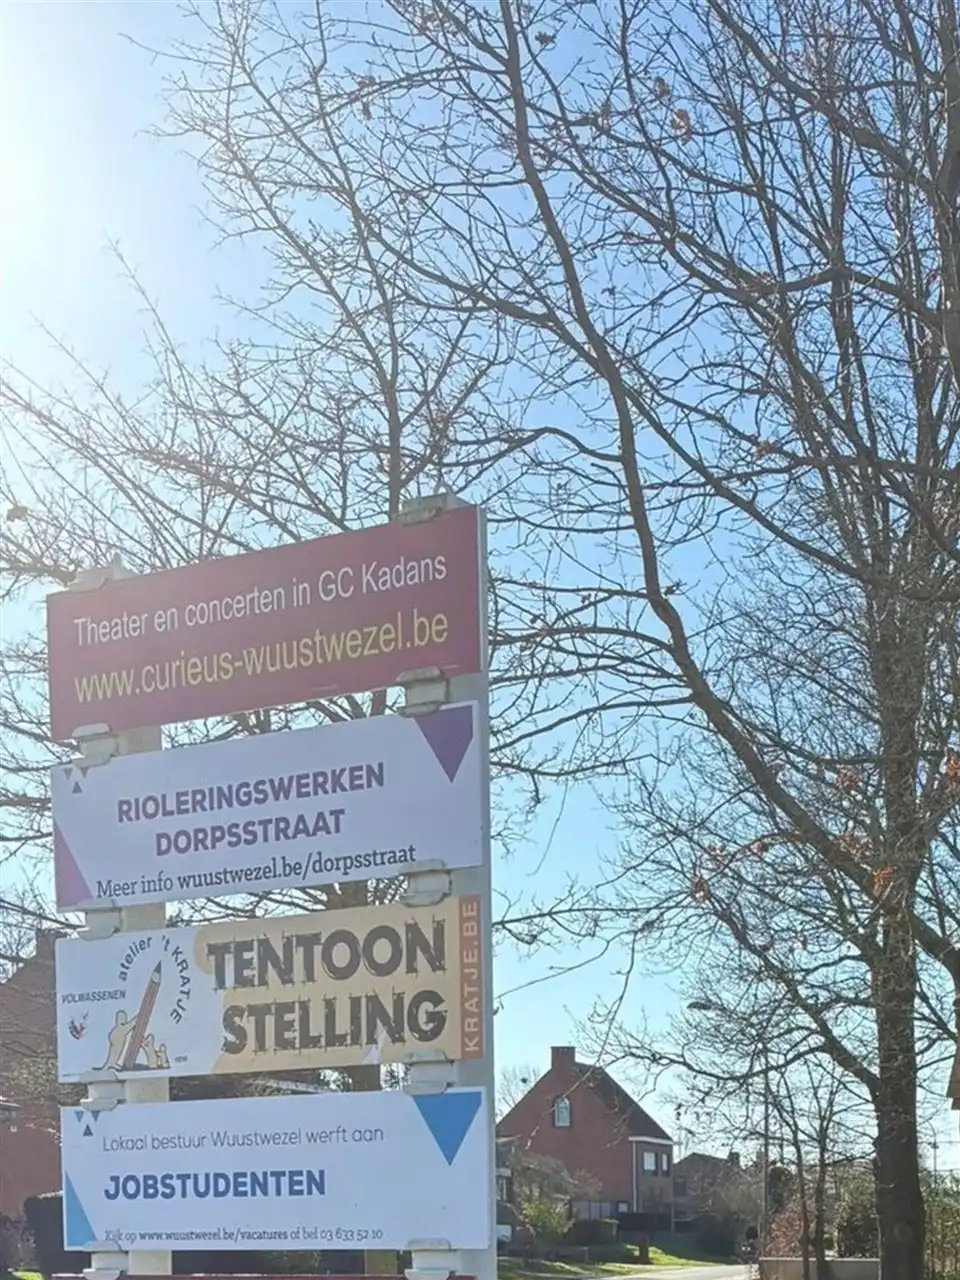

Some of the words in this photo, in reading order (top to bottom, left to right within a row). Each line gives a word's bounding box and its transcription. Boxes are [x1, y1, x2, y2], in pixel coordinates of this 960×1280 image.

[74, 613, 148, 646] Theater
[154, 609, 178, 633] en
[185, 586, 285, 627] concerten
[292, 578, 310, 606] in
[318, 568, 354, 601] GC
[361, 553, 447, 593] Kadans
[74, 608, 449, 704] www.curieus-wuustwezel.be
[117, 761, 385, 824] RIOLERINGSWERKEN
[155, 809, 346, 857] DORPSSTRAAT
[96, 877, 137, 899] Meer
[141, 871, 174, 894] info
[177, 844, 416, 890] wuustwezel.be/dorpsstraat
[119, 936, 153, 982] atelier
[170, 945, 191, 1025] KRATJE
[207, 914, 448, 991] TENTOON
[462, 900, 480, 1053] KRATJE.BE
[61, 989, 126, 1004] VOLWASSENEN
[222, 987, 449, 1055] STELLING
[102, 1134, 148, 1153] Lokaal
[151, 1131, 207, 1151] bestuur
[211, 1128, 301, 1149] Wuustwezel
[305, 1126, 348, 1145] werft
[352, 1126, 384, 1143] aan
[104, 1169, 327, 1201] JOBSTUDENTEN
[125, 1231, 137, 1244] op
[290, 1226, 300, 1240] of
[302, 1226, 318, 1240] bel
[320, 1229, 333, 1241] 03
[335, 1227, 354, 1242] 633
[356, 1228, 369, 1241] 52
[371, 1229, 383, 1240] 10
